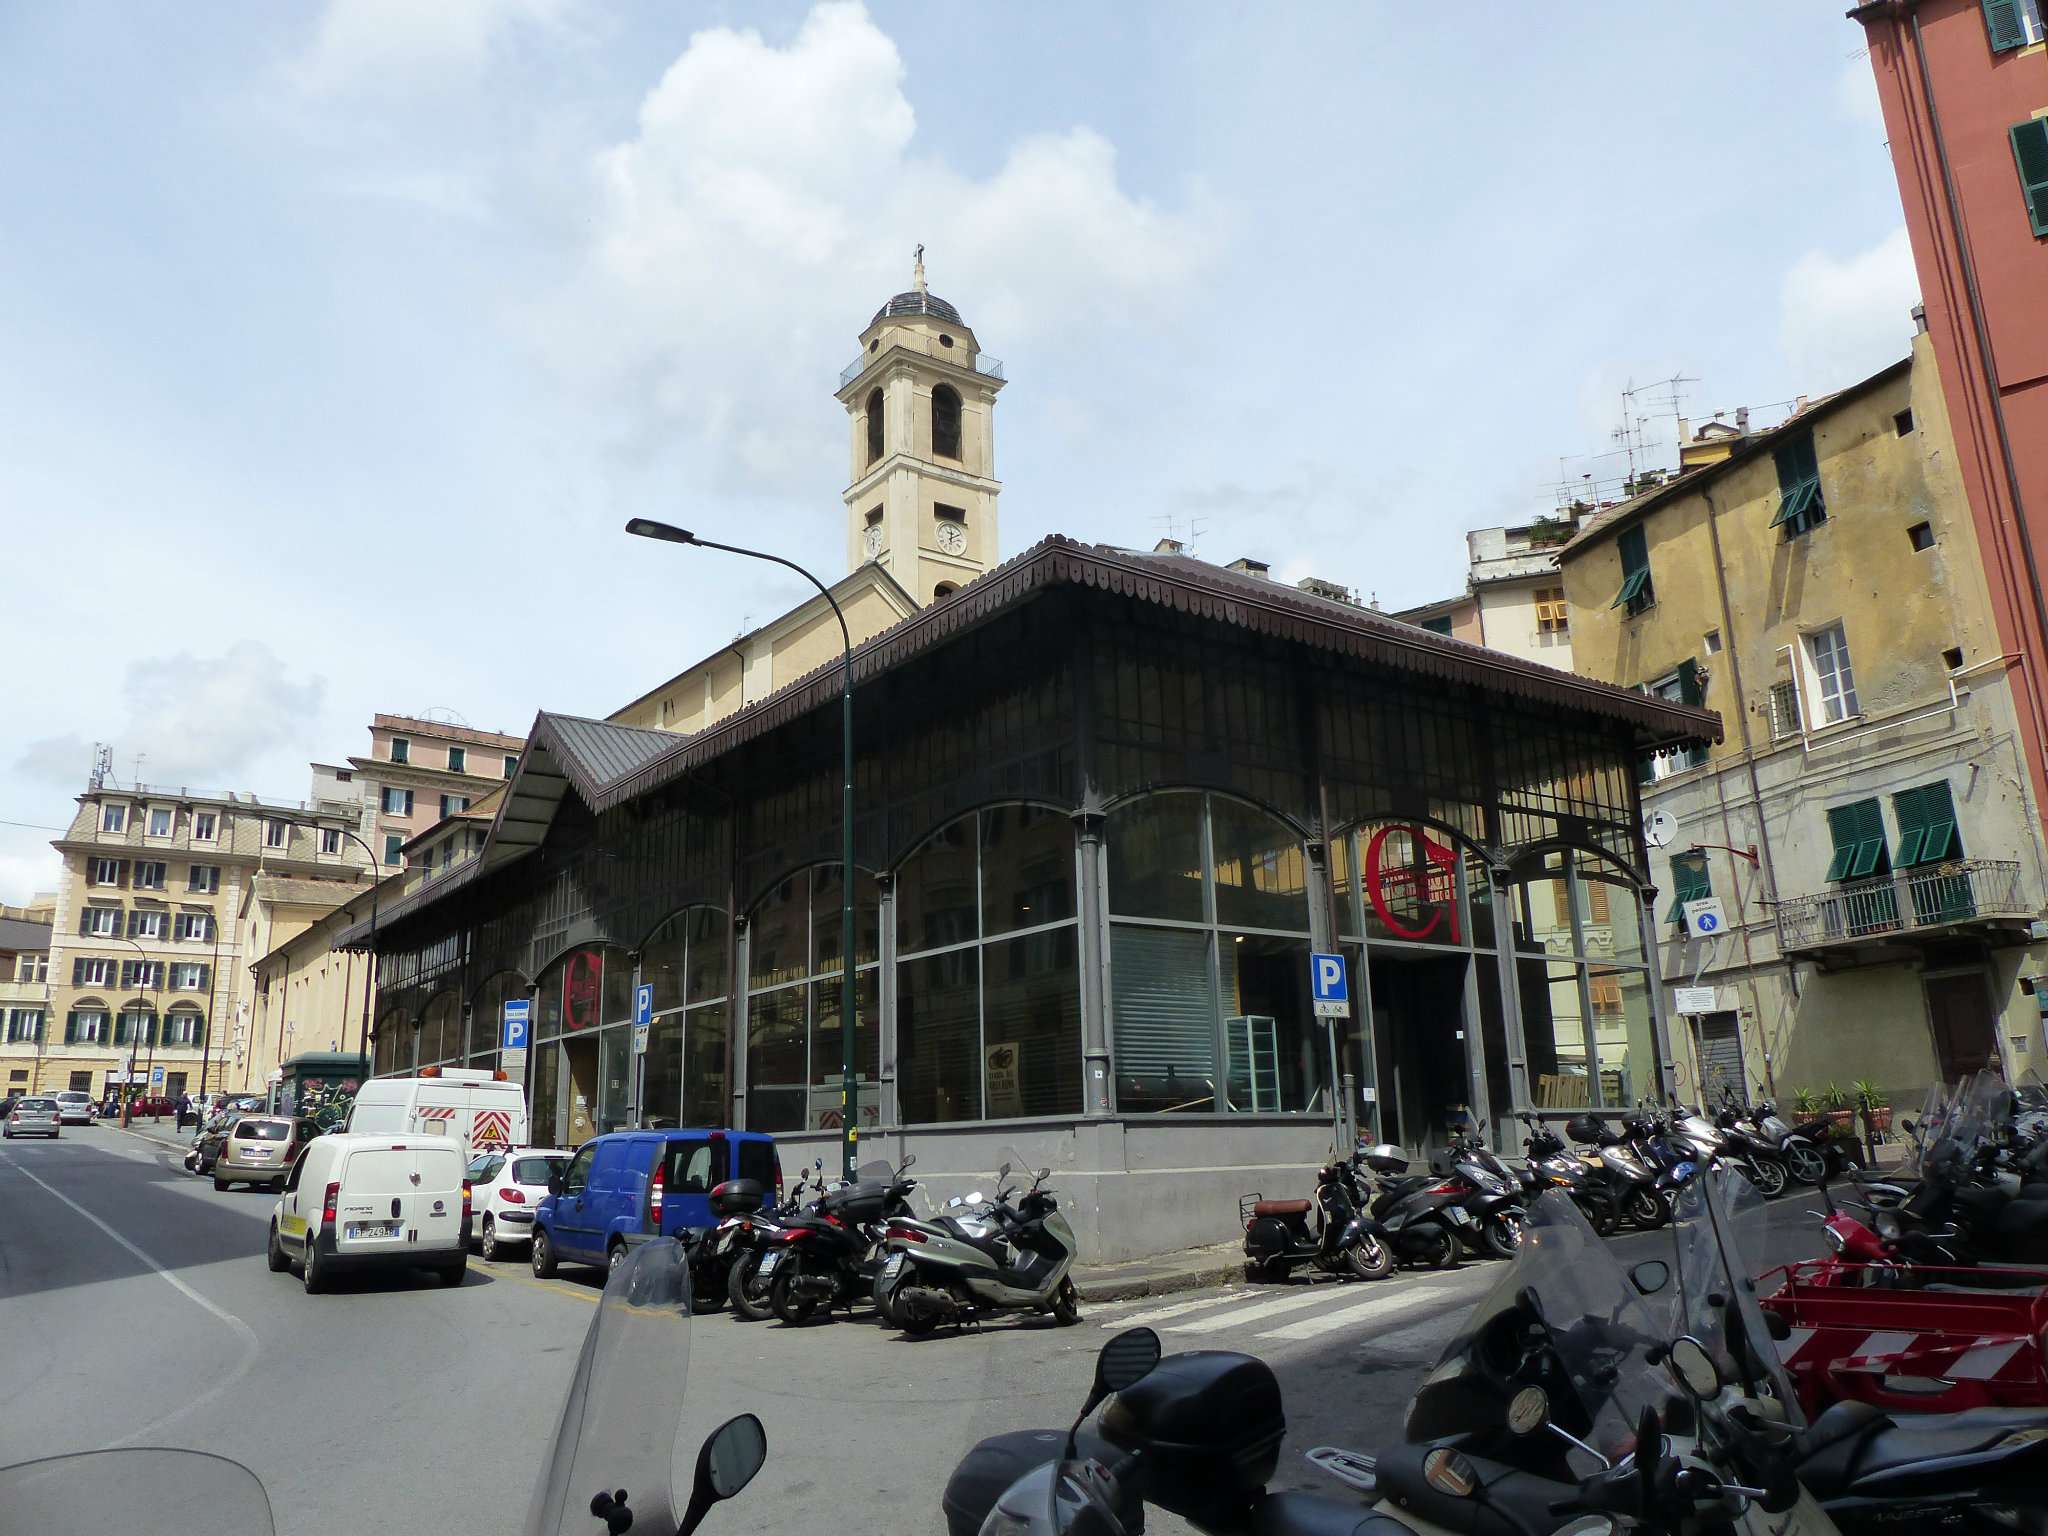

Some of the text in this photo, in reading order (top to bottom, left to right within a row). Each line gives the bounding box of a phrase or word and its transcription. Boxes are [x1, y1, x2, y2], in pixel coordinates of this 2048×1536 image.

[1319, 959, 1341, 995] P
[638, 989, 649, 1022] P
[508, 1023, 523, 1045] P
[154, 1073, 162, 1081] P
